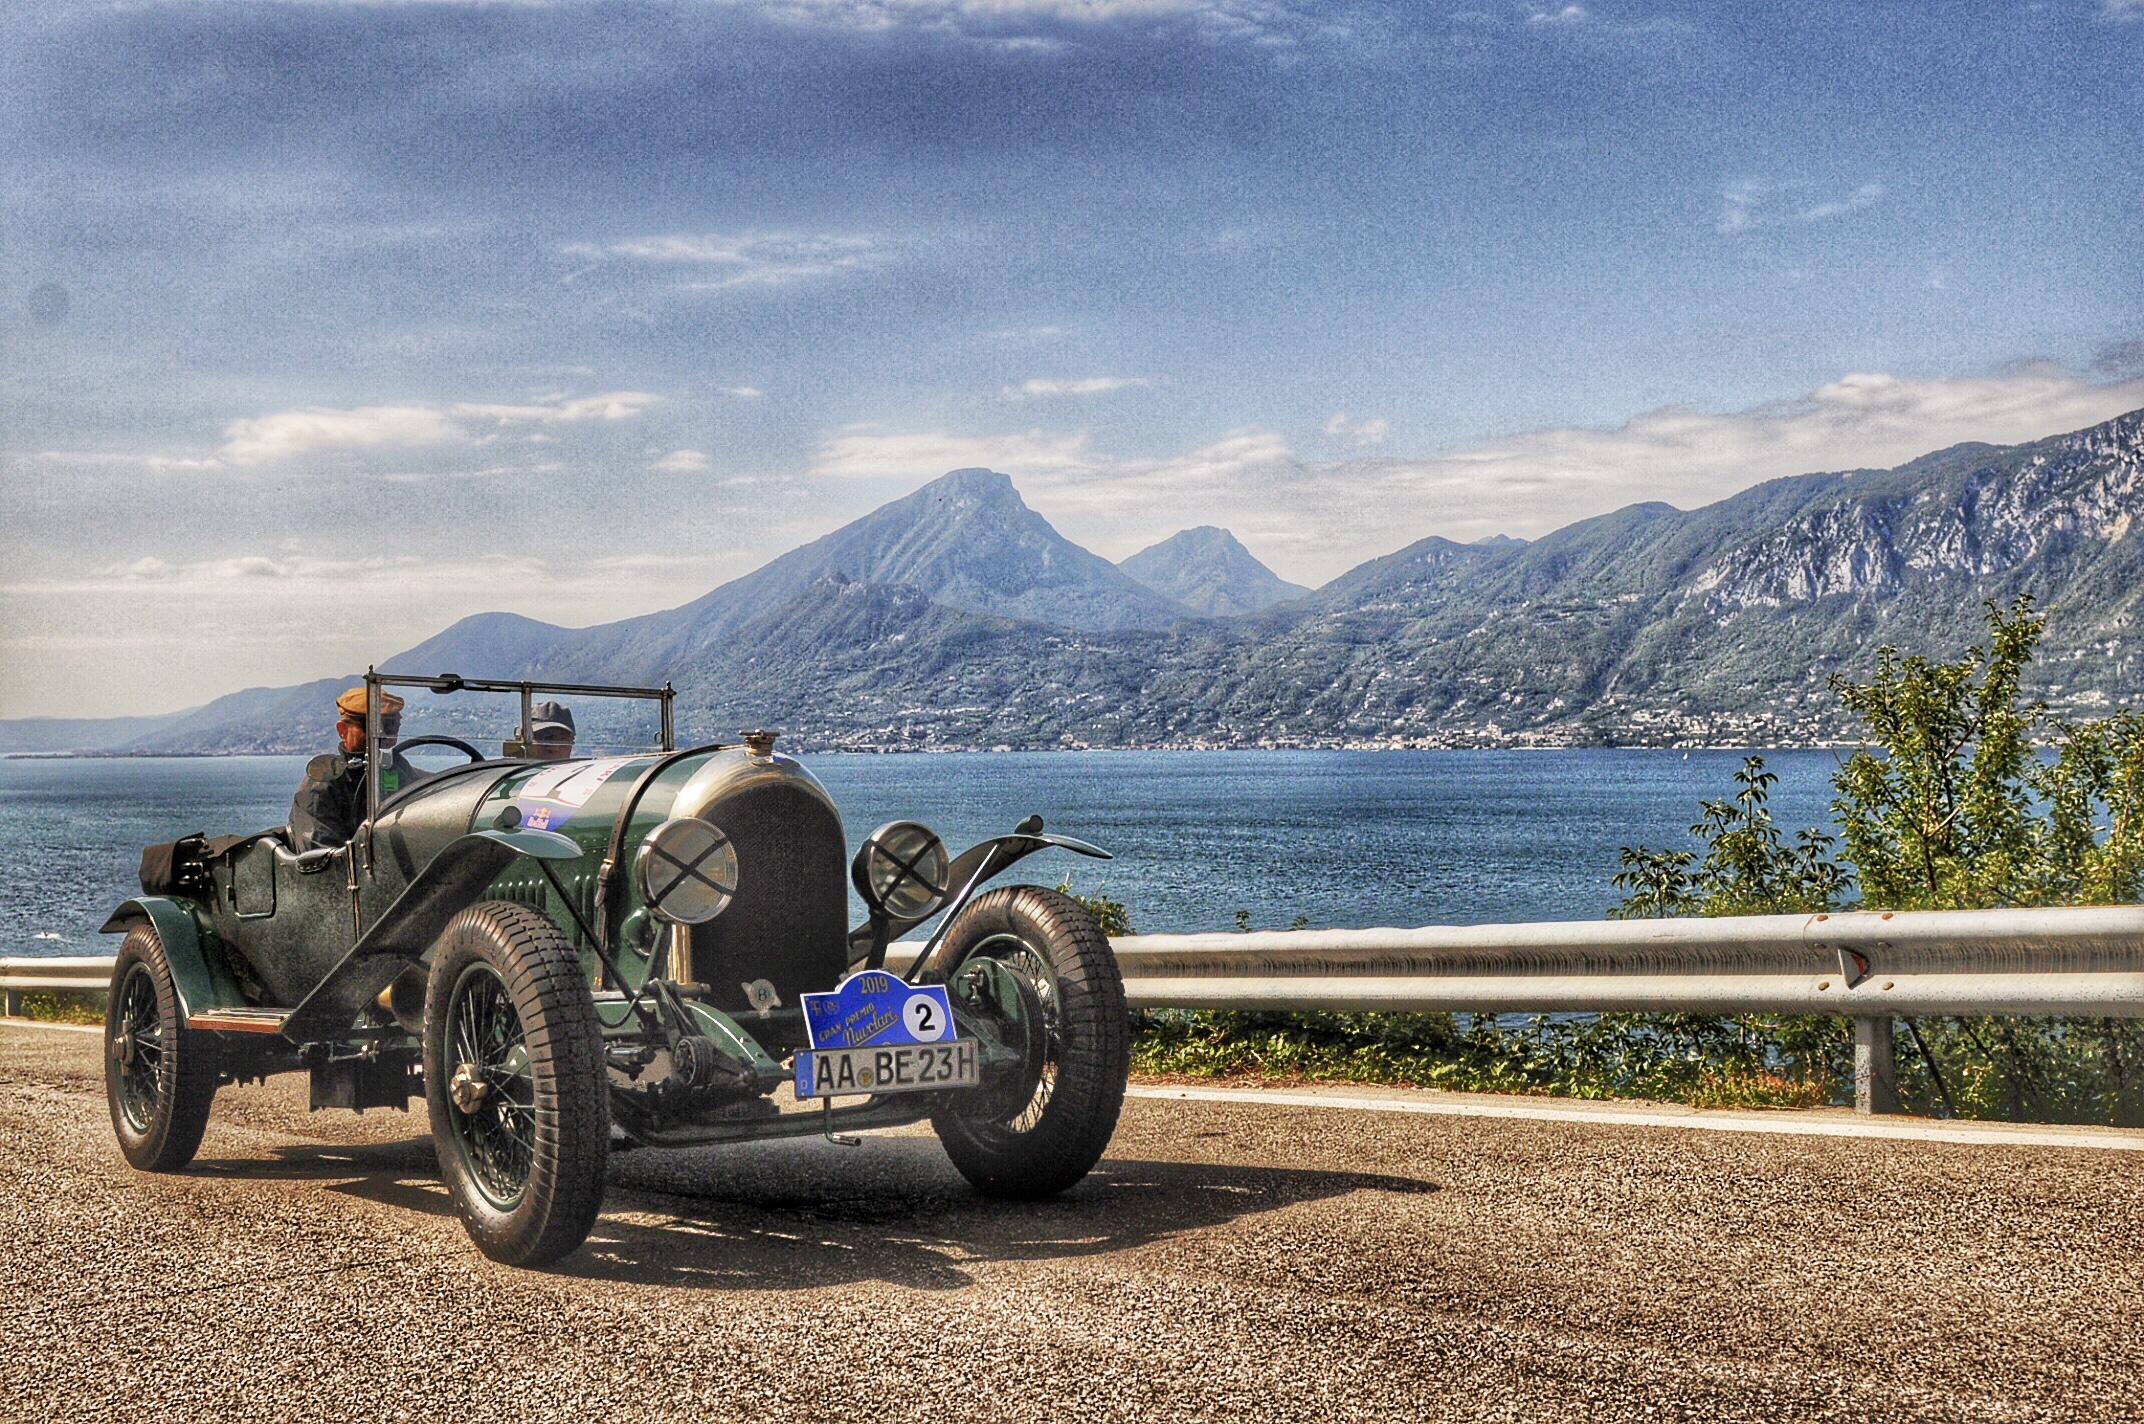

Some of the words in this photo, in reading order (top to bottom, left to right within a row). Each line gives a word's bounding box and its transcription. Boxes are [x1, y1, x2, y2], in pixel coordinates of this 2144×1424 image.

[758, 988, 768, 1001] B
[858, 975, 889, 995] 2019
[818, 1022, 842, 1043] GRAN
[845, 1002, 875, 1027] PREMIO
[842, 1006, 898, 1047] Nuvolari
[915, 1003, 936, 1032] 2
[816, 1053, 856, 1090] AA
